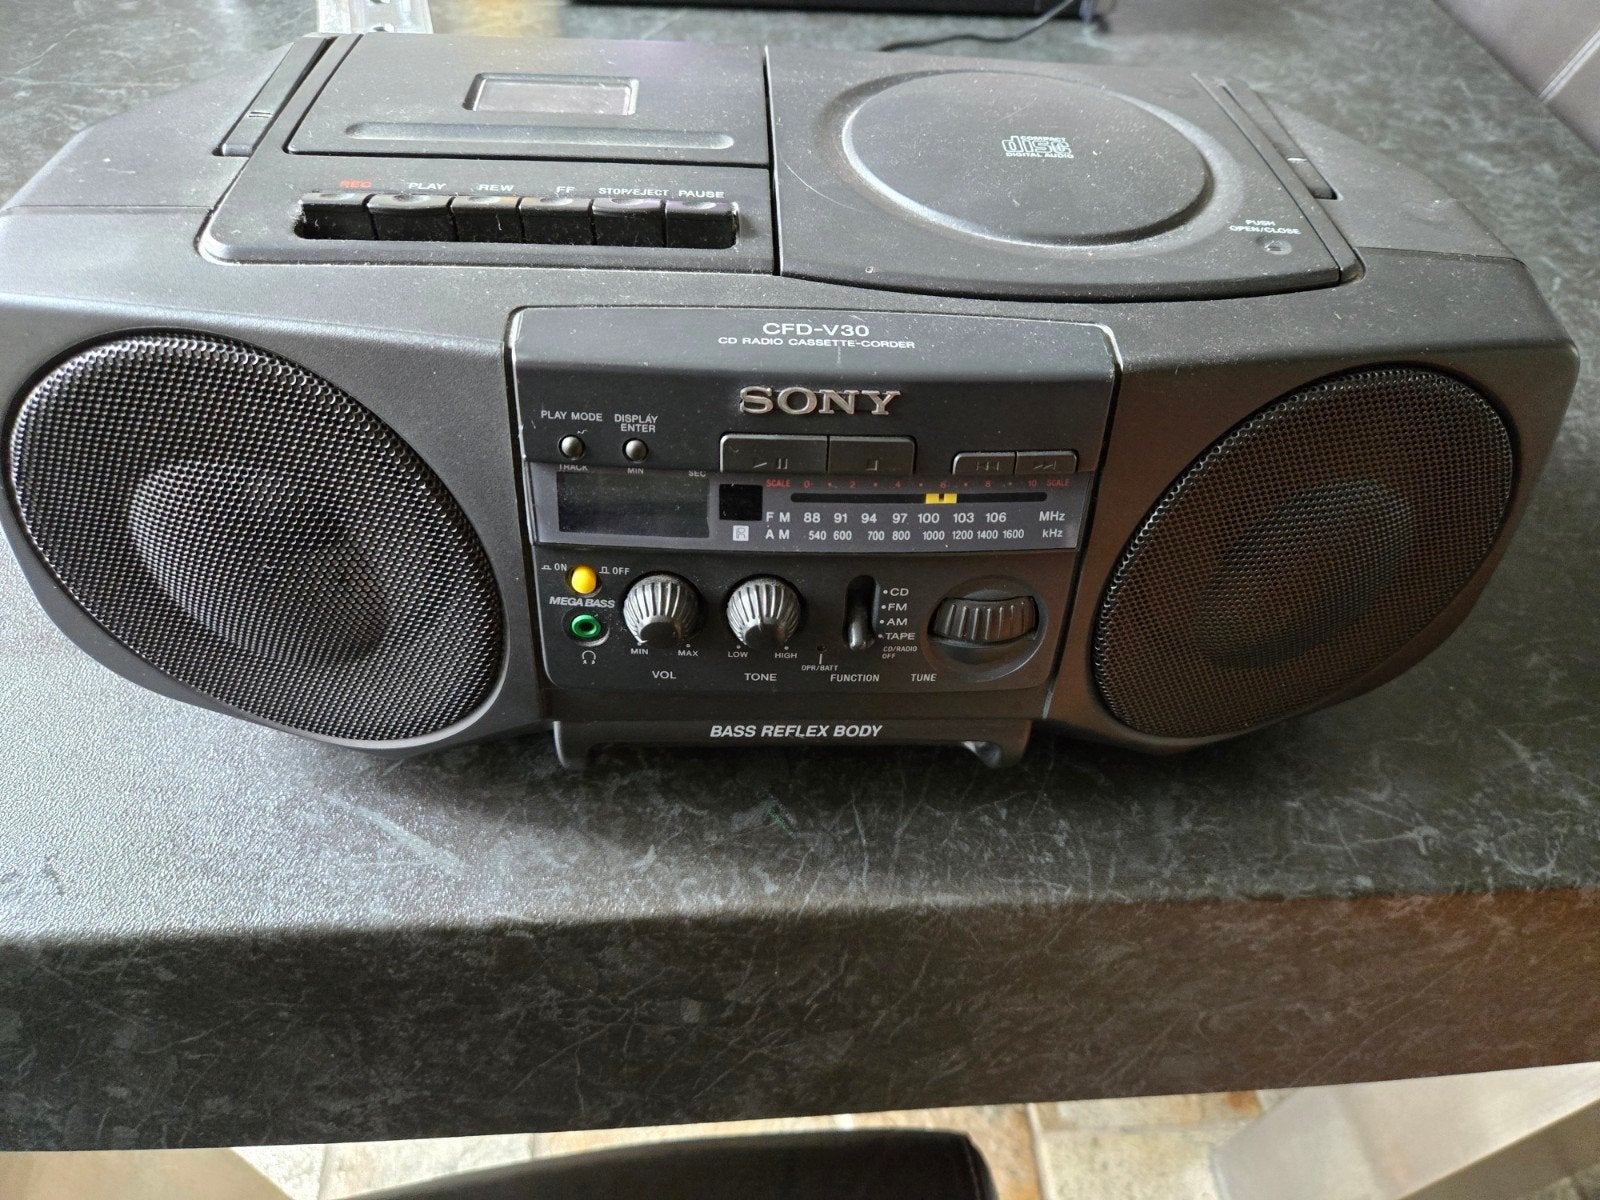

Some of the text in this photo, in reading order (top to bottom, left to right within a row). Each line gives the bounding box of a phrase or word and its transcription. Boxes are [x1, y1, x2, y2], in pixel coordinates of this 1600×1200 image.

[339, 180, 373, 189] REC
[408, 182, 447, 190] PLAY
[478, 184, 514, 192] REW
[556, 186, 575, 194] FF
[598, 187, 670, 197] STOP/EJECT
[678, 189, 725, 199] PAUSE
[1229, 225, 1301, 235] OPEN/CLOSE
[762, 322, 870, 337] CFD-V30
[718, 336, 916, 349] CD RADIO CASSETTE-CORDER
[738, 385, 901, 416] SONY
[540, 410, 603, 422] PLAY MODE
[614, 413, 658, 424] DISPLAY
[620, 423, 656, 433] ENTER
[627, 467, 644, 475] MIN
[765, 479, 791, 488] SCALE
[850, 481, 857, 489] 2
[1046, 478, 1070, 487] SCALE
[803, 512, 821, 524] 88
[833, 512, 848, 524] 91
[861, 513, 878, 524] 94
[892, 513, 908, 524] 97
[918, 512, 940, 524] 100
[953, 512, 975, 524] 103
[986, 512, 1007, 523] 106
[1039, 510, 1066, 522] MHz
[808, 530, 827, 541] 540
[833, 530, 852, 541] 600
[867, 531, 885, 541] 700
[892, 530, 911, 541] 800
[923, 530, 946, 541] 1000
[952, 530, 974, 540] 1200
[977, 529, 999, 540] 1400
[1003, 529, 1025, 539] 1600
[1042, 528, 1063, 538] kHz
[554, 563, 568, 572] ON
[612, 567, 630, 576] OFF
[889, 587, 909, 597] CD
[549, 596, 616, 609] MEGA BASS
[887, 603, 907, 612] FM
[886, 618, 908, 626] AM
[885, 632, 916, 641] TAPE
[630, 648, 649, 656] MIN
[883, 645, 918, 653] CD/RADIO
[727, 651, 749, 659] LOW
[801, 664, 839, 673] OPR/BATT
[652, 671, 677, 680] VOL
[744, 673, 778, 682] TONE
[830, 674, 880, 683] FUNCTION
[911, 673, 938, 682] TUNE
[709, 725, 883, 738] BASS REFLEX BODY
